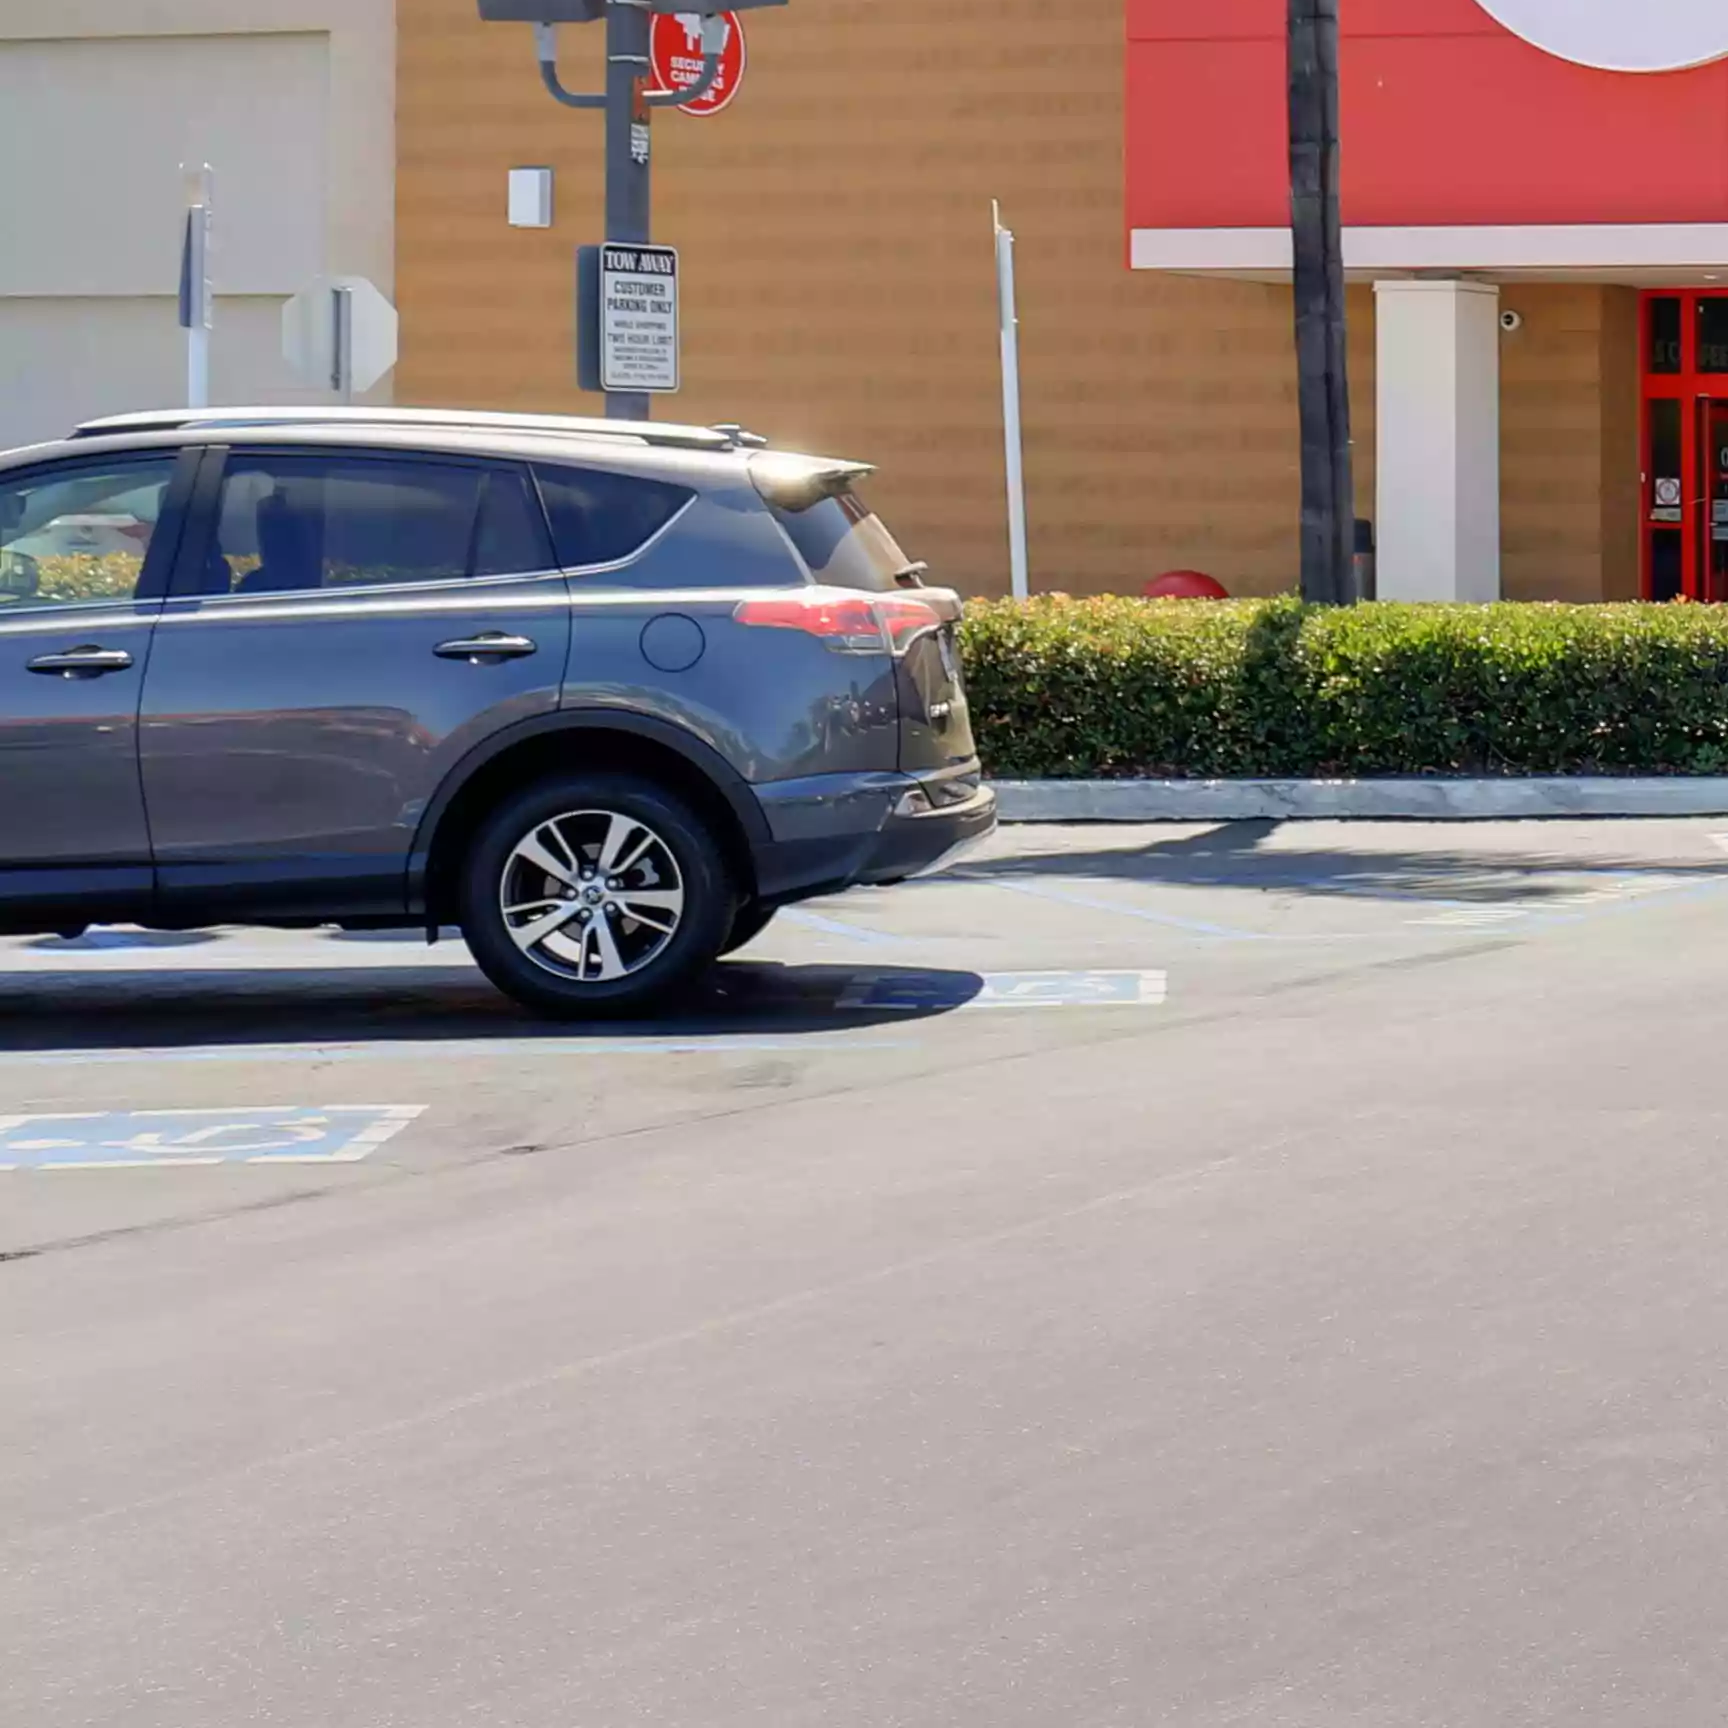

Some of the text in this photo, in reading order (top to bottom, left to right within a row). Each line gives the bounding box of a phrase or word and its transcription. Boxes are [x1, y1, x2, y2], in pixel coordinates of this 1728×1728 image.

[604, 251, 674, 273] TOW AWAY
[614, 280, 665, 297] CUSTOMER
[607, 298, 672, 314] PARKING ONLY
